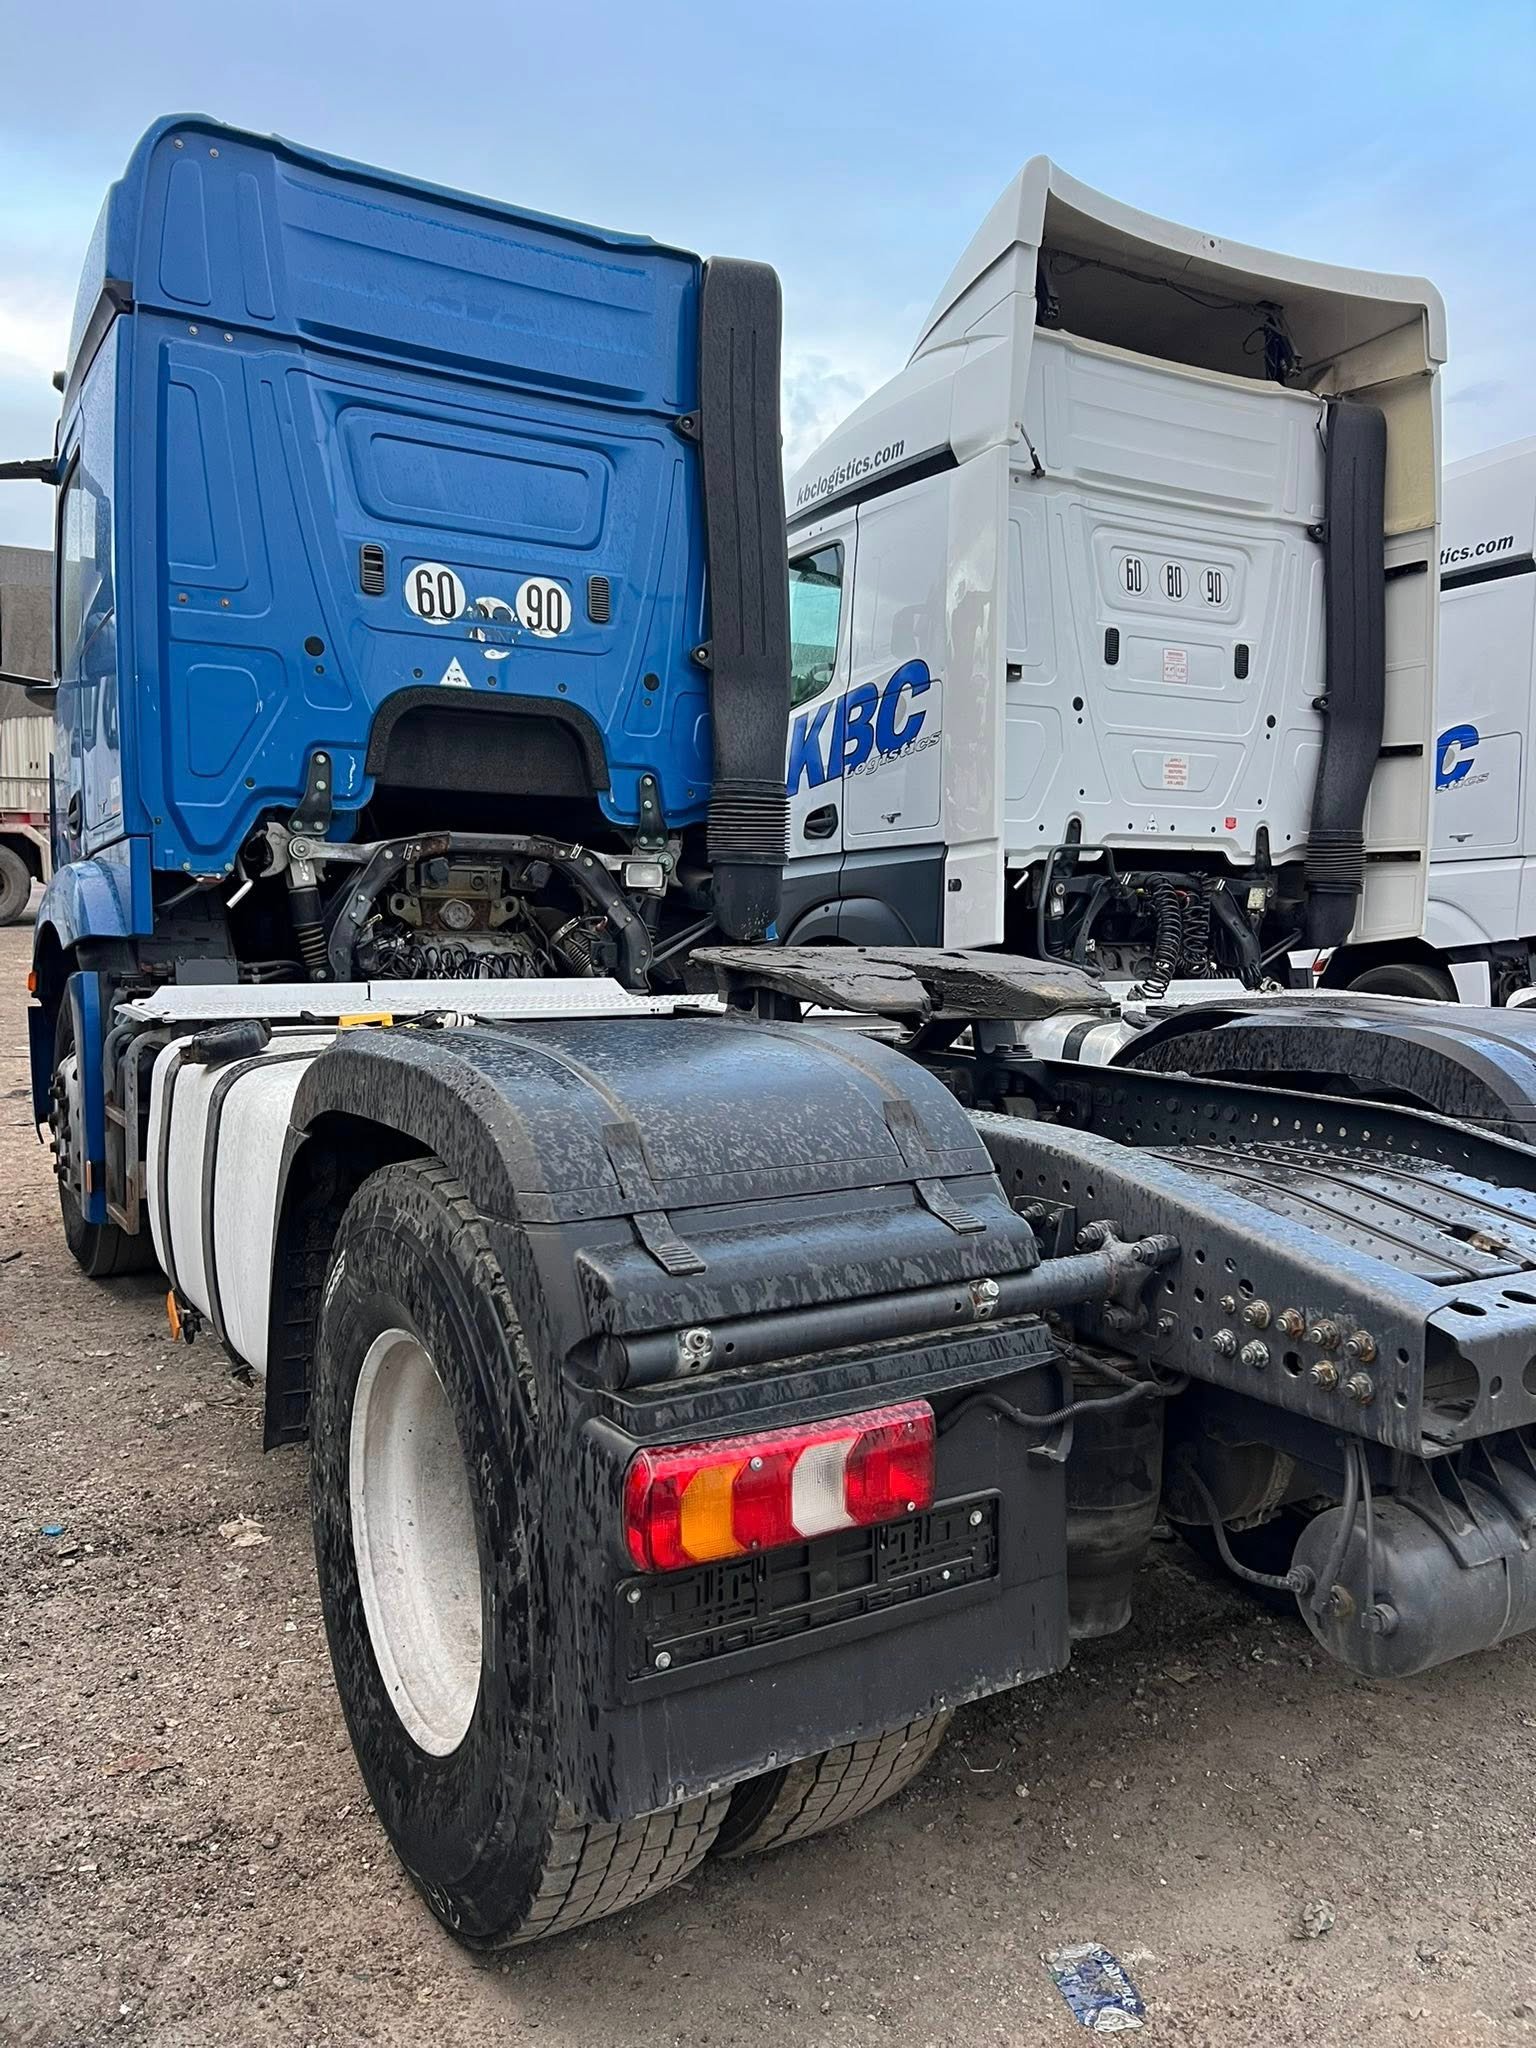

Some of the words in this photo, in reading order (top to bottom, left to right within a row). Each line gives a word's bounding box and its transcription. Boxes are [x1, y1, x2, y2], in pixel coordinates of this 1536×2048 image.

[796, 440, 905, 507] kbclogistics.com
[416, 569, 456, 618] 60
[526, 584, 562, 634] 90
[1126, 558, 1142, 592] 60
[1167, 565, 1182, 598] 80
[1207, 571, 1222, 604] 90
[786, 658, 931, 798] KBC
[842, 731, 942, 781] Logistics
